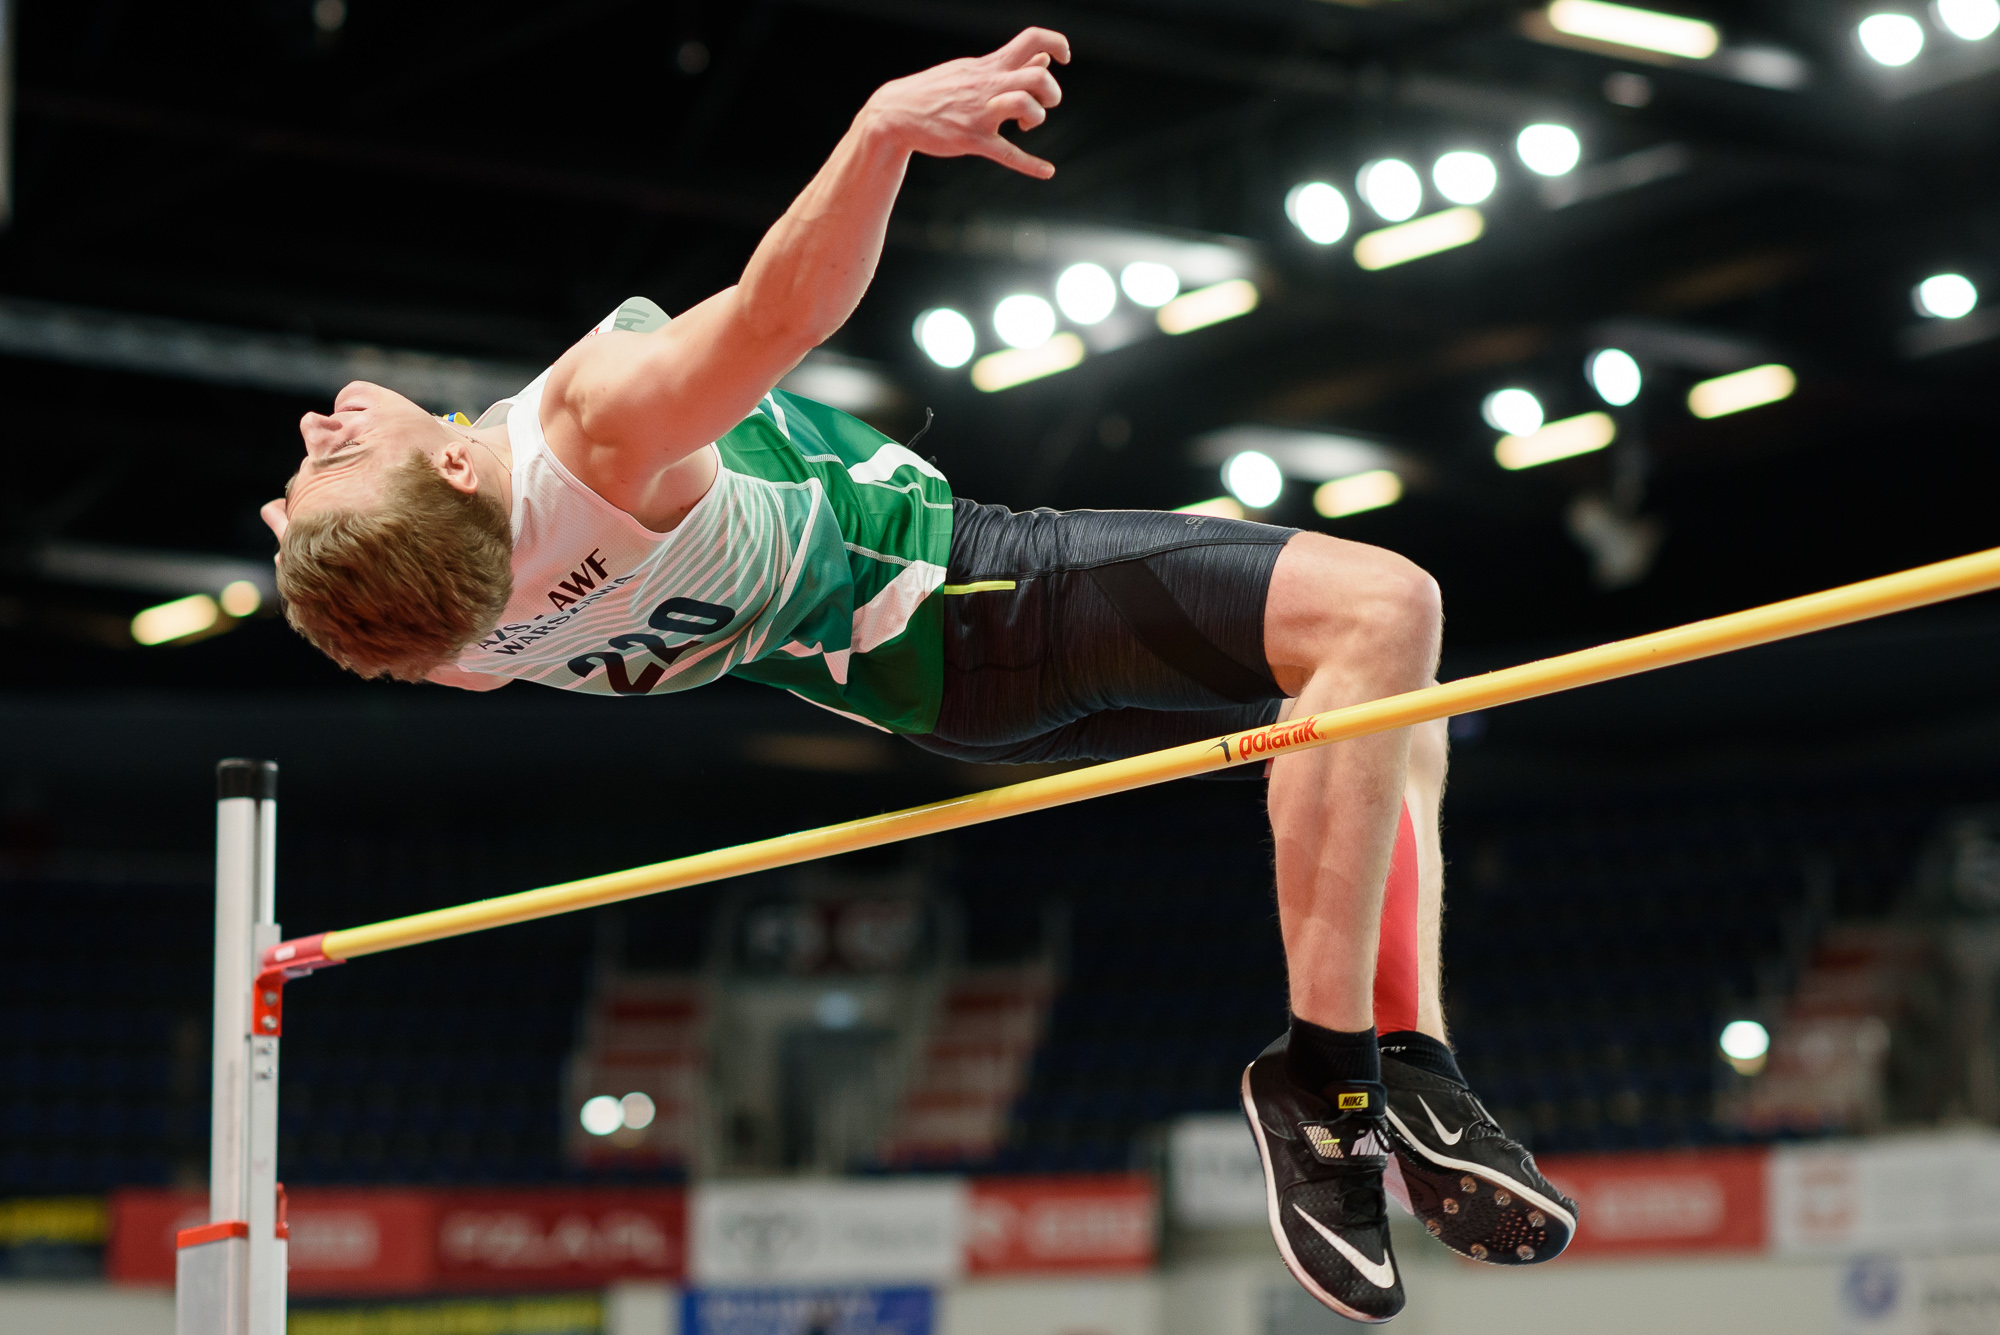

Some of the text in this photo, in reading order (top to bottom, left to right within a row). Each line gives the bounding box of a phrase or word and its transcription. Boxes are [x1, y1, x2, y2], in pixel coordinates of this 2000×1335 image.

[478, 622, 531, 650] AZS
[547, 548, 609, 612] AWF
[567, 596, 736, 696] 220
[1239, 716, 1319, 761] polanik
[1342, 1096, 1364, 1107] NIKE
